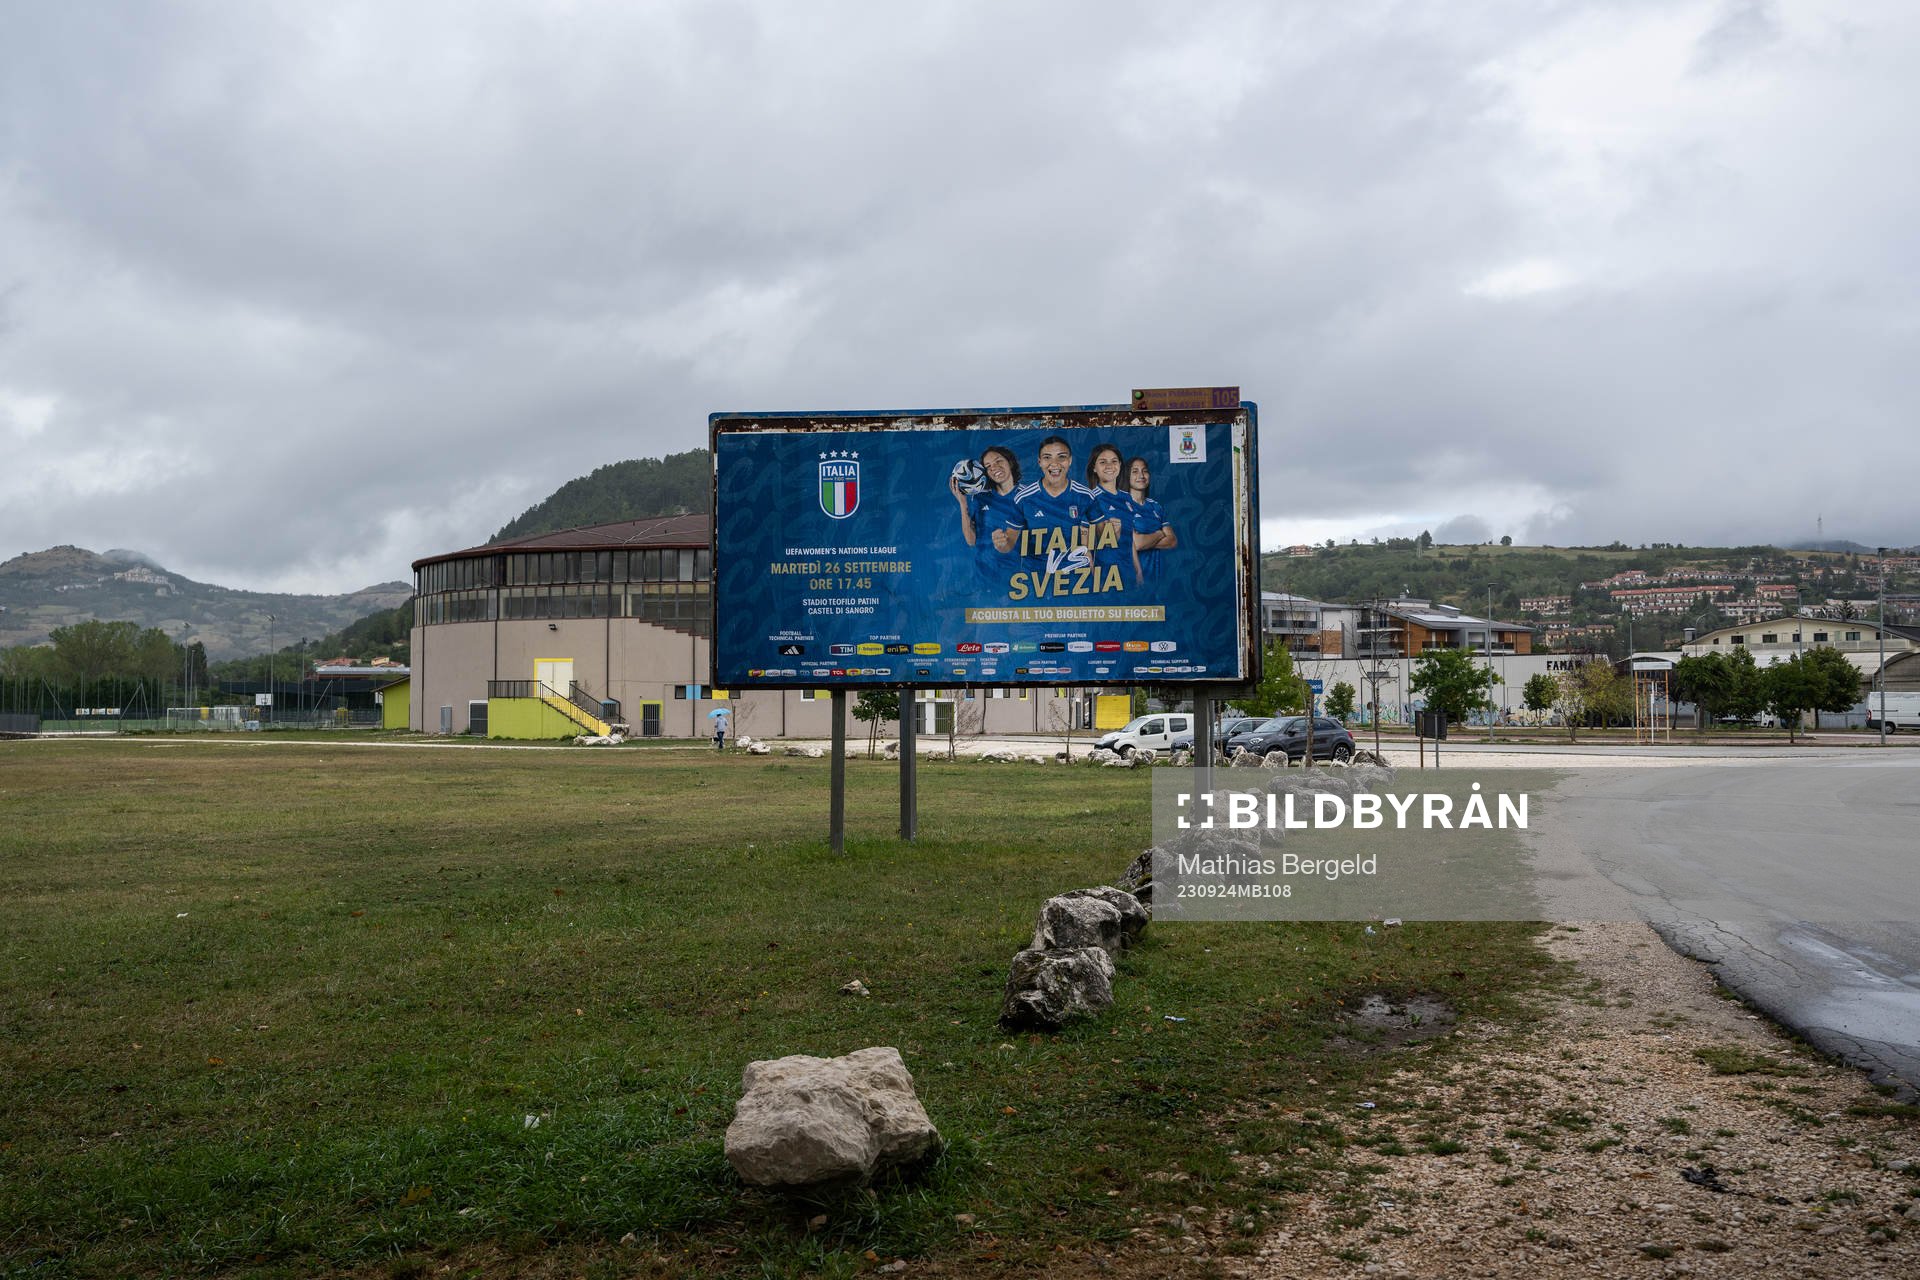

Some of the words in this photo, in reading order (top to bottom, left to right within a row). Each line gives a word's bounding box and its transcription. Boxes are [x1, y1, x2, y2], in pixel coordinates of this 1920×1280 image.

[1214, 390, 1237, 407] 105
[822, 465, 857, 477] ITALIA
[1020, 523, 1119, 557] ITALIA
[838, 547, 868, 555] NATIONS
[870, 546, 897, 554] LEAGUE
[771, 560, 821, 575] MARTEDÌ
[825, 562, 841, 574] 26
[844, 561, 912, 573] SETTEMBRE
[810, 578, 833, 590] ORE
[838, 577, 872, 590] 17.45
[1008, 564, 1124, 600] SVEZIA
[802, 598, 828, 606] STADIO
[829, 598, 856, 606] TEOFILO
[857, 597, 879, 605] PATINI
[808, 607, 834, 615] CASTEL
[835, 607, 844, 615] DI
[845, 606, 874, 614] SANGRO
[971, 610, 1020, 621] ACQUISTA
[1022, 610, 1031, 620] IL
[1034, 609, 1053, 620] TUO
[1056, 609, 1105, 619] BIGLIETTO
[1108, 608, 1122, 618] SU
[1125, 608, 1159, 618] FIGC.IT
